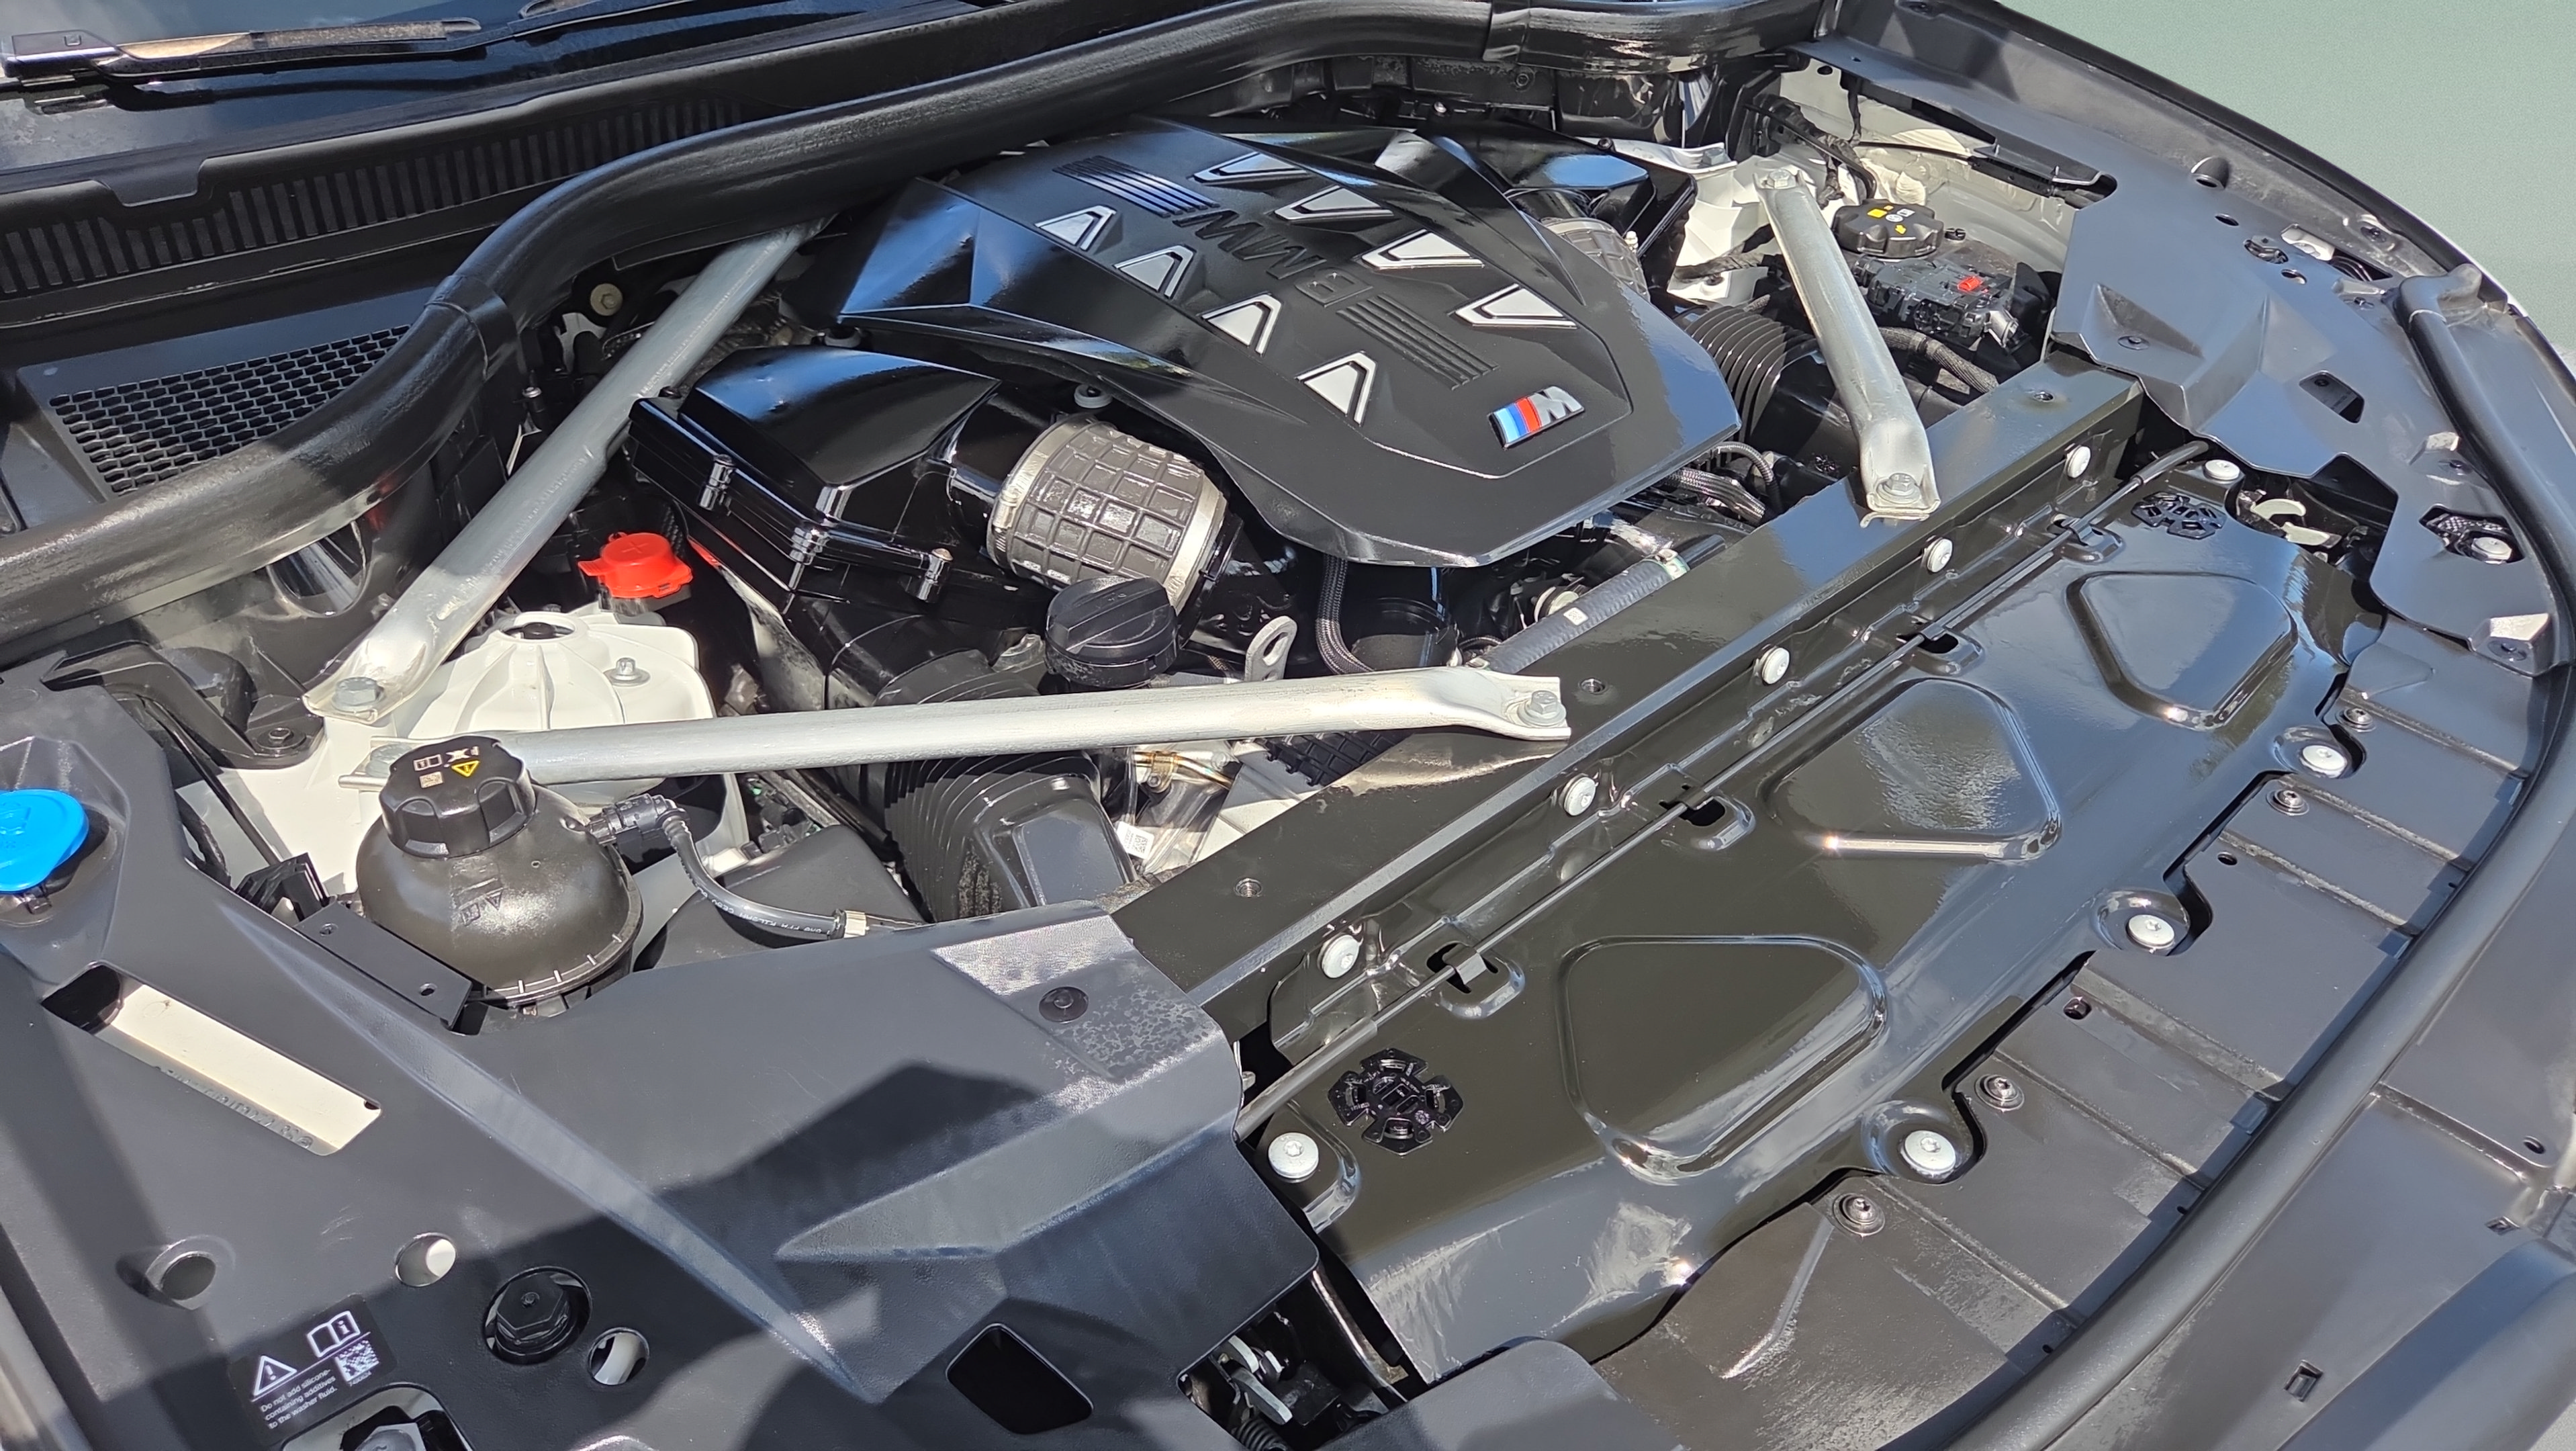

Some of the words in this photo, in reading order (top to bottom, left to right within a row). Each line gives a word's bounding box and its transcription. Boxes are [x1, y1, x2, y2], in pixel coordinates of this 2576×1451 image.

[1172, 209, 1374, 308] BMW
[261, 1402, 273, 1412] Do
[273, 1395, 286, 1405] not
[287, 1385, 302, 1398] add
[301, 1369, 331, 1389] silicone-
[265, 1395, 304, 1421] containing
[304, 1376, 336, 1397] additives
[269, 1420, 279, 1429] to
[277, 1412, 291, 1424] the
[291, 1396, 318, 1416] washer
[318, 1386, 338, 1401] fluid.
